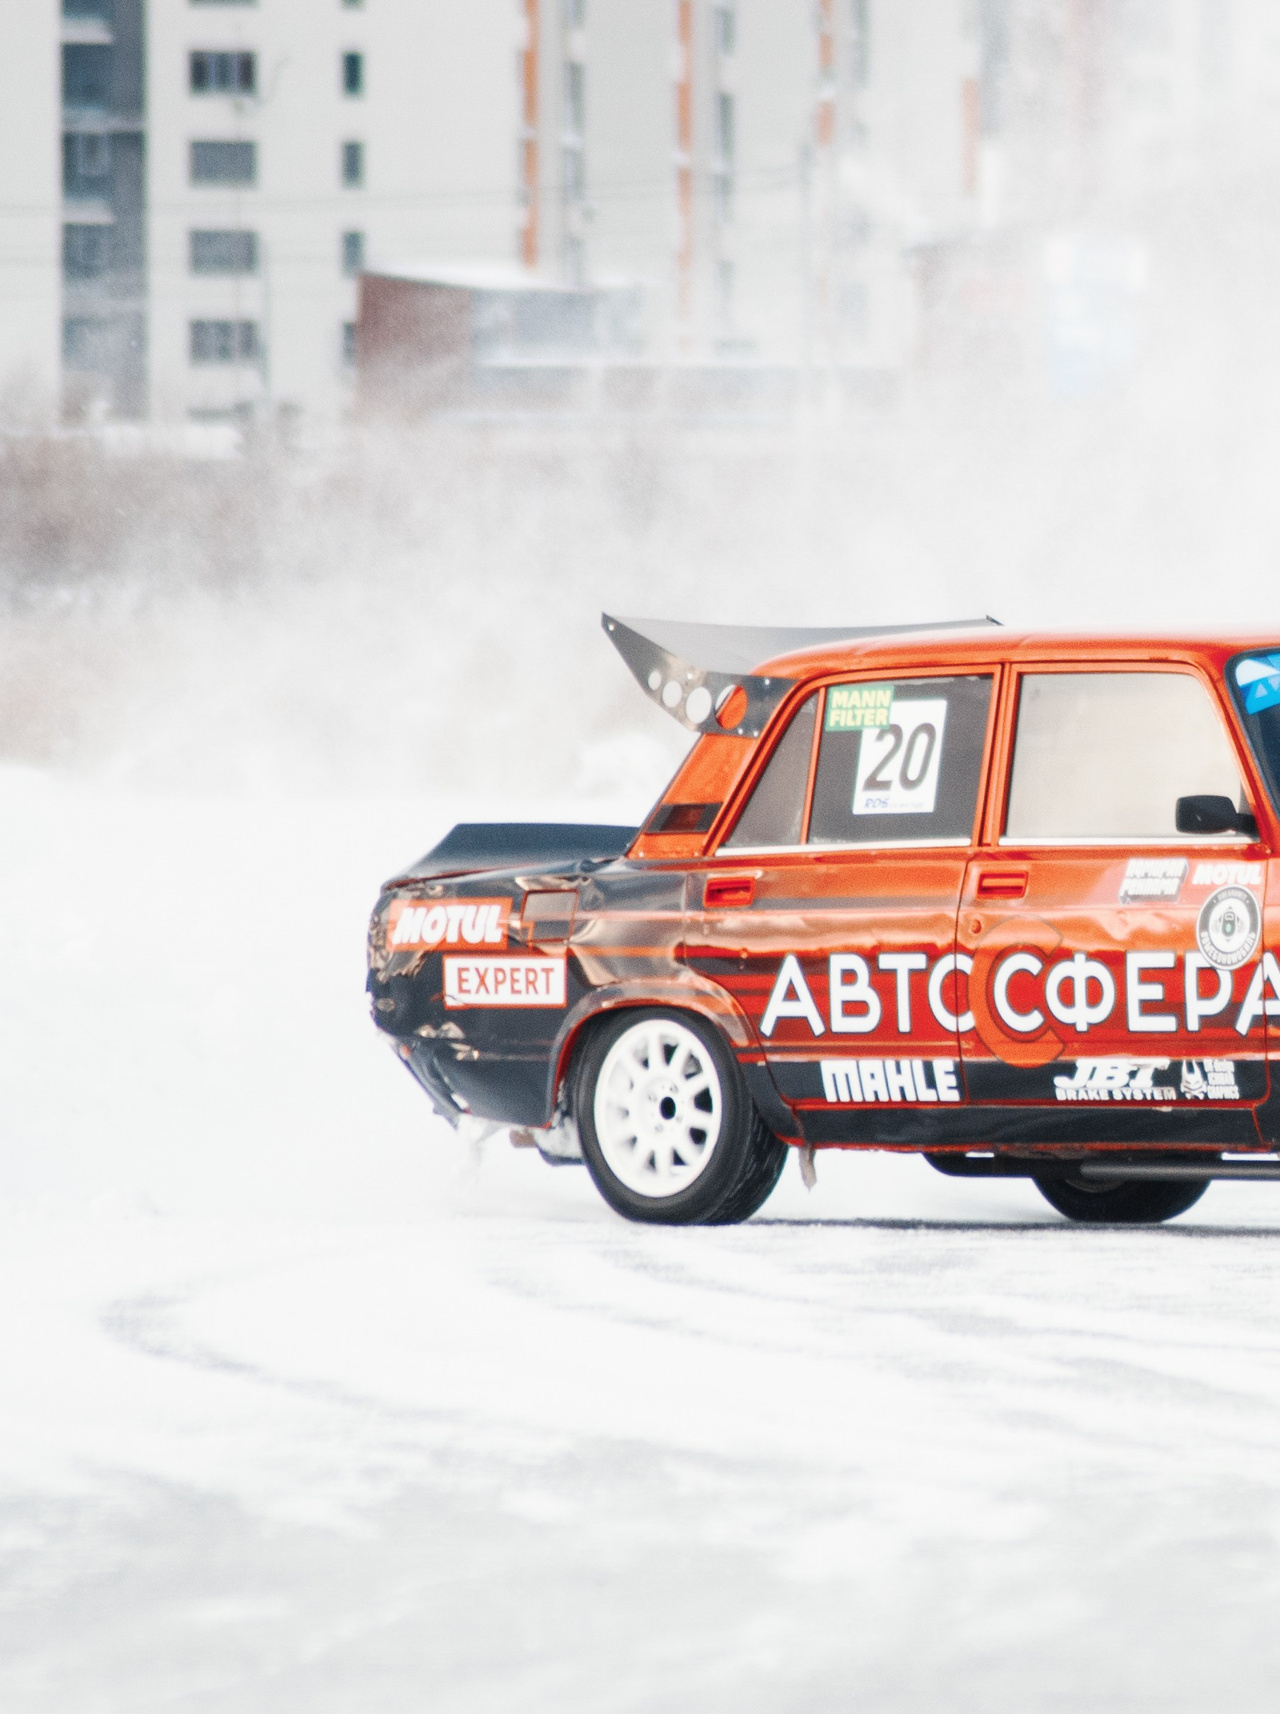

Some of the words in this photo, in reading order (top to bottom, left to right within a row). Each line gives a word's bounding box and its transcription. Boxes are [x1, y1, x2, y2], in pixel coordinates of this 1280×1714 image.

[832, 690, 891, 709] MANN
[829, 708, 888, 727] FILTER
[862, 722, 936, 792] 20
[1192, 864, 1261, 885] MOTUL
[392, 904, 503, 944] MOTUL
[457, 966, 555, 995] EXPERT
[820, 1059, 960, 1103] MAHLE
[1053, 1058, 1171, 1089] JBT
[1055, 1087, 1110, 1101] BRAKE
[1112, 1086, 1177, 1101] SYSTEM
